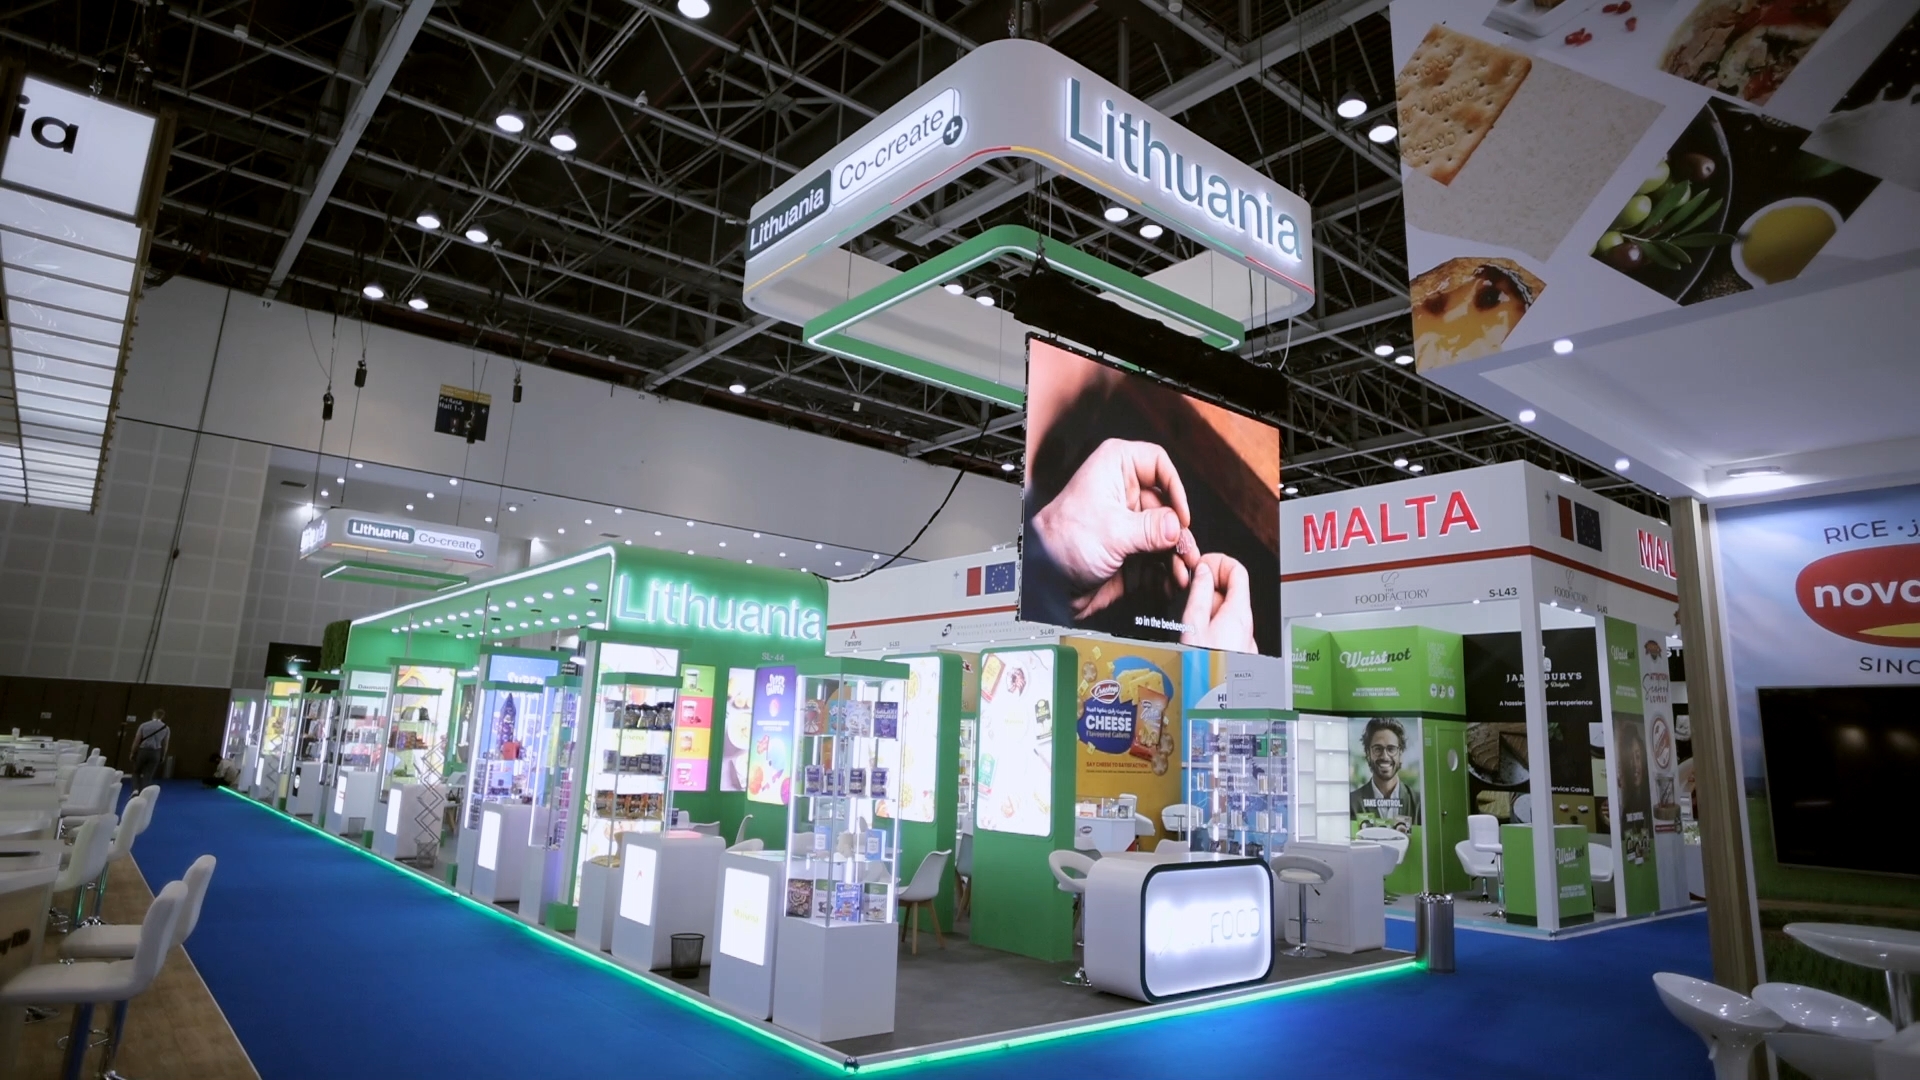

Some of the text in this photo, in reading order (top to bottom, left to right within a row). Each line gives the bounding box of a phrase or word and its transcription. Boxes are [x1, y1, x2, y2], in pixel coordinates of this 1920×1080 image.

[1066, 77, 1302, 263] Lithuania
[751, 109, 944, 251] Lithuania Co-create
[1303, 489, 1481, 555] MALTA
[352, 521, 477, 550] Lithuania Co-create
[1824, 520, 1889, 544] RICE
[1637, 528, 1678, 580] MAL
[1355, 588, 1430, 605] FOODFACTORY
[1489, 587, 1518, 598] S-L43
[616, 574, 823, 641] Lithuania
[1135, 616, 1143, 625] so
[1143, 615, 1150, 626] in
[1150, 616, 1161, 628] the
[1040, 628, 1055, 636] S-L49
[761, 652, 785, 661] SL-44
[1291, 648, 1320, 662] aistnot
[1339, 648, 1411, 668] Waistnot
[1085, 714, 1132, 732] CHEESE
[1363, 799, 1377, 807] TAKE
